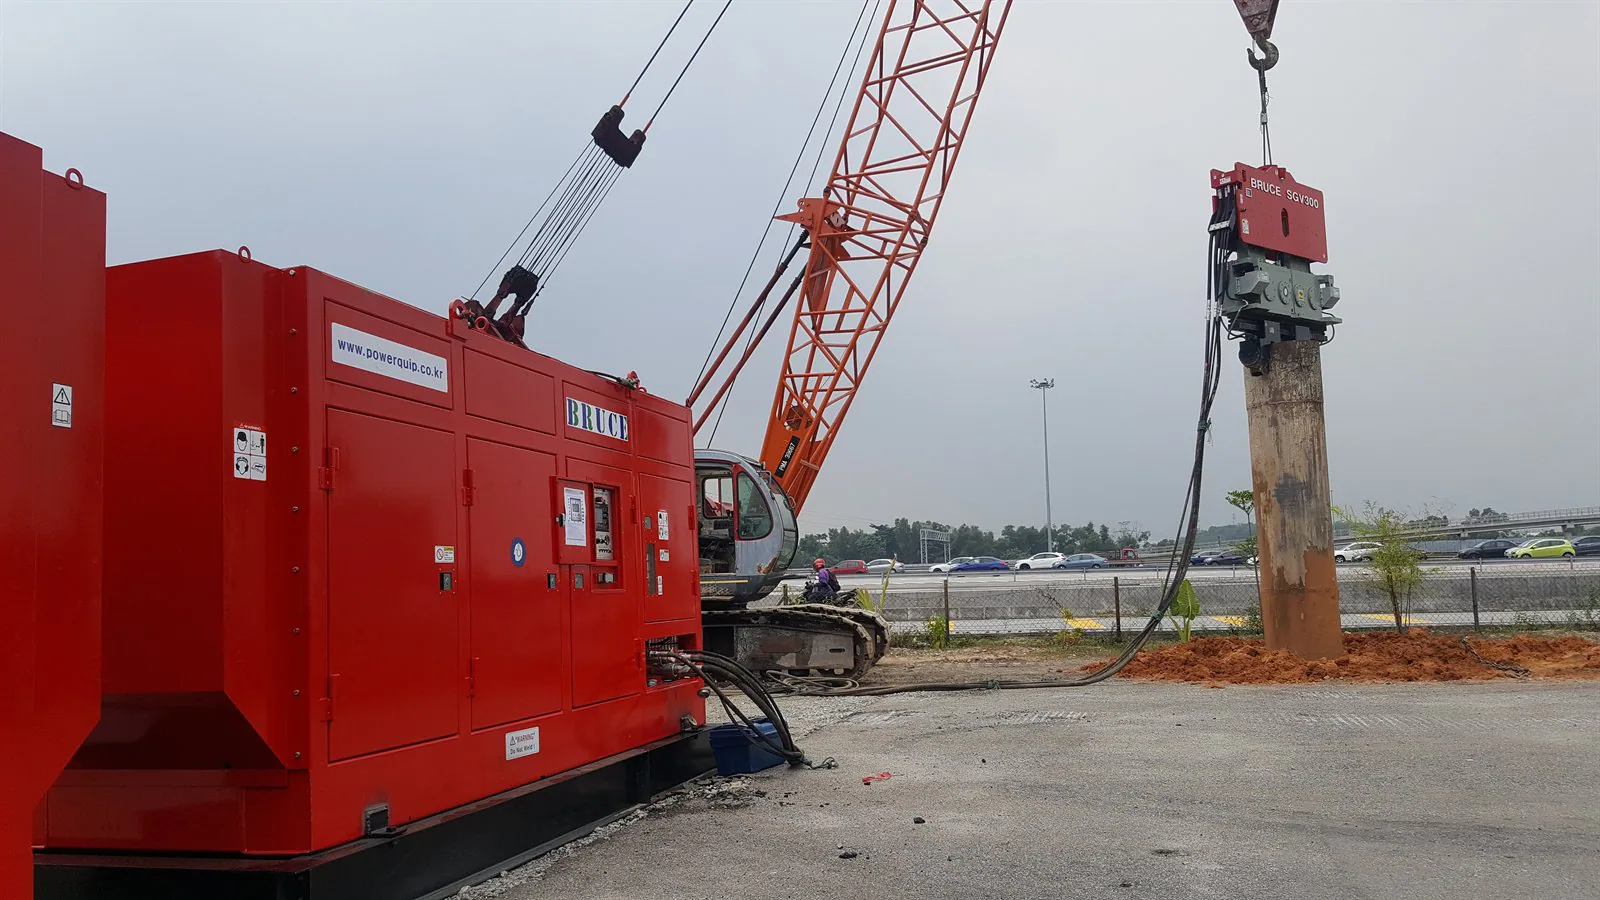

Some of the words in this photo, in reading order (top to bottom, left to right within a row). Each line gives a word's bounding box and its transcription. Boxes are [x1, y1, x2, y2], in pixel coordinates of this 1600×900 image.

[1250, 177, 1282, 197] BRUCE
[1286, 189, 1319, 209] SGV300
[337, 339, 444, 379] www.powerquip.co.kr
[567, 398, 629, 440] BRUCE
